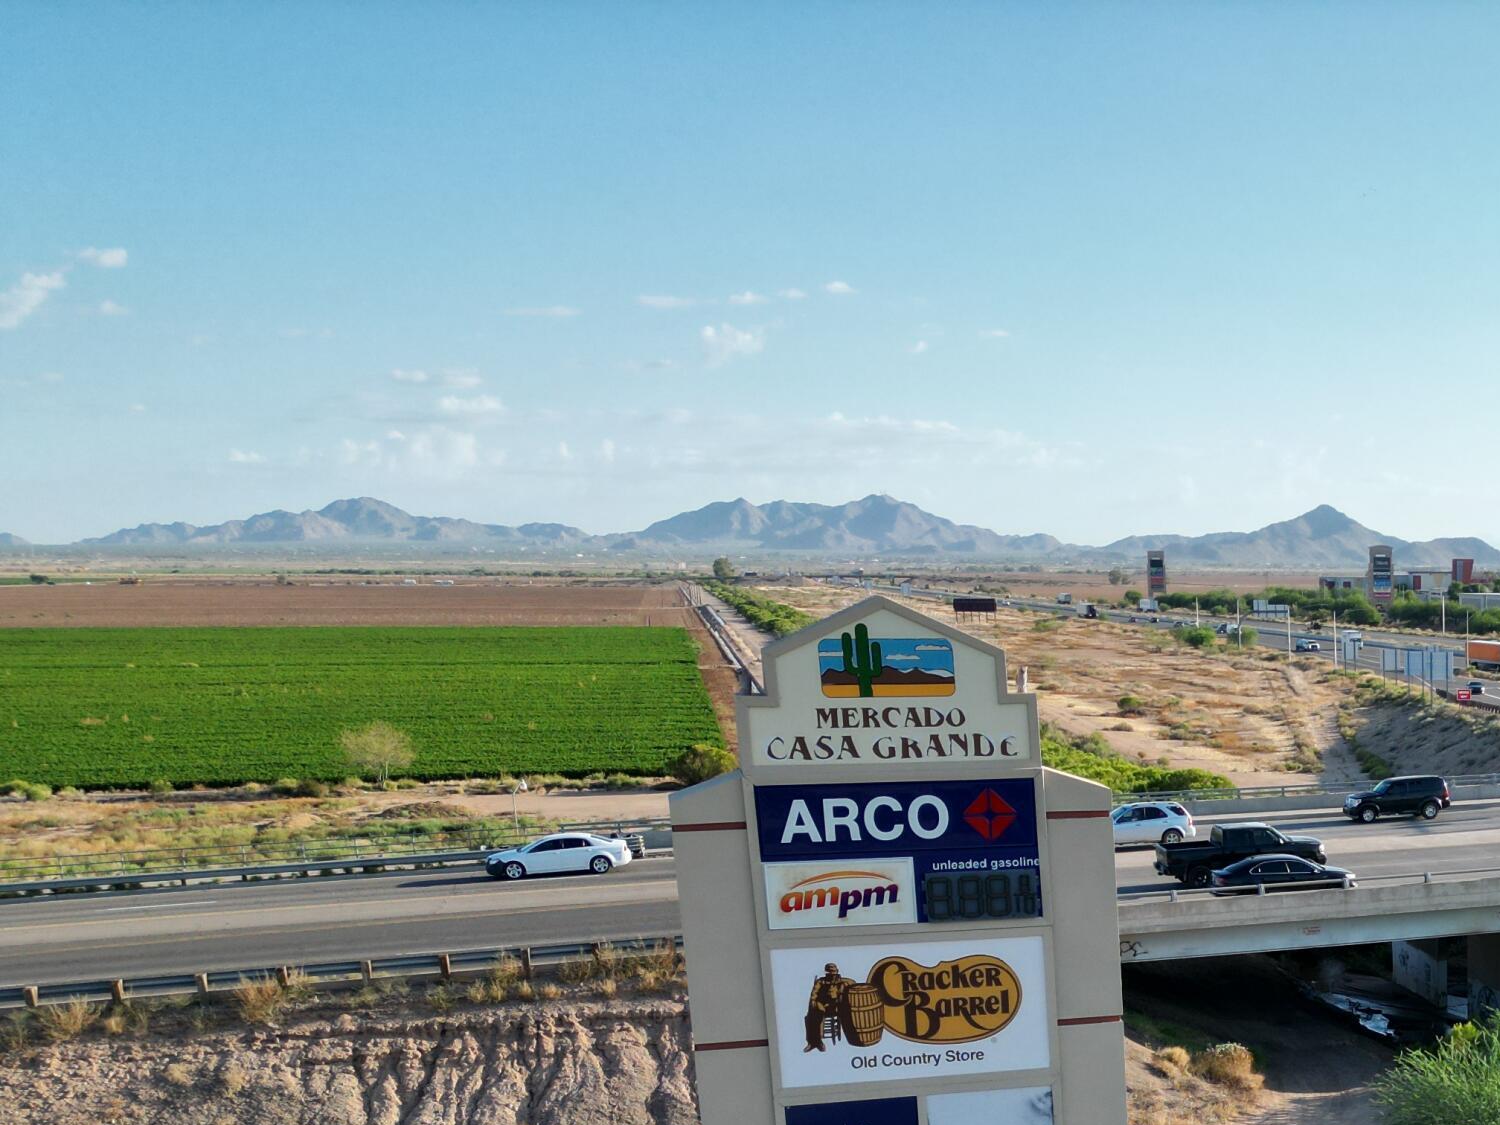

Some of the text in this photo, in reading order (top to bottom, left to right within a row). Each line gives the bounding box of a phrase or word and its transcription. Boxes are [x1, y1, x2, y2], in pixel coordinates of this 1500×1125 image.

[816, 707, 966, 729] MERCADO
[767, 733, 1019, 761] CASA GRANDE
[781, 794, 950, 844] ARCO
[932, 858, 987, 870] unleaded
[780, 882, 900, 918] ampm
[851, 1050, 985, 1069] Old Country Store
